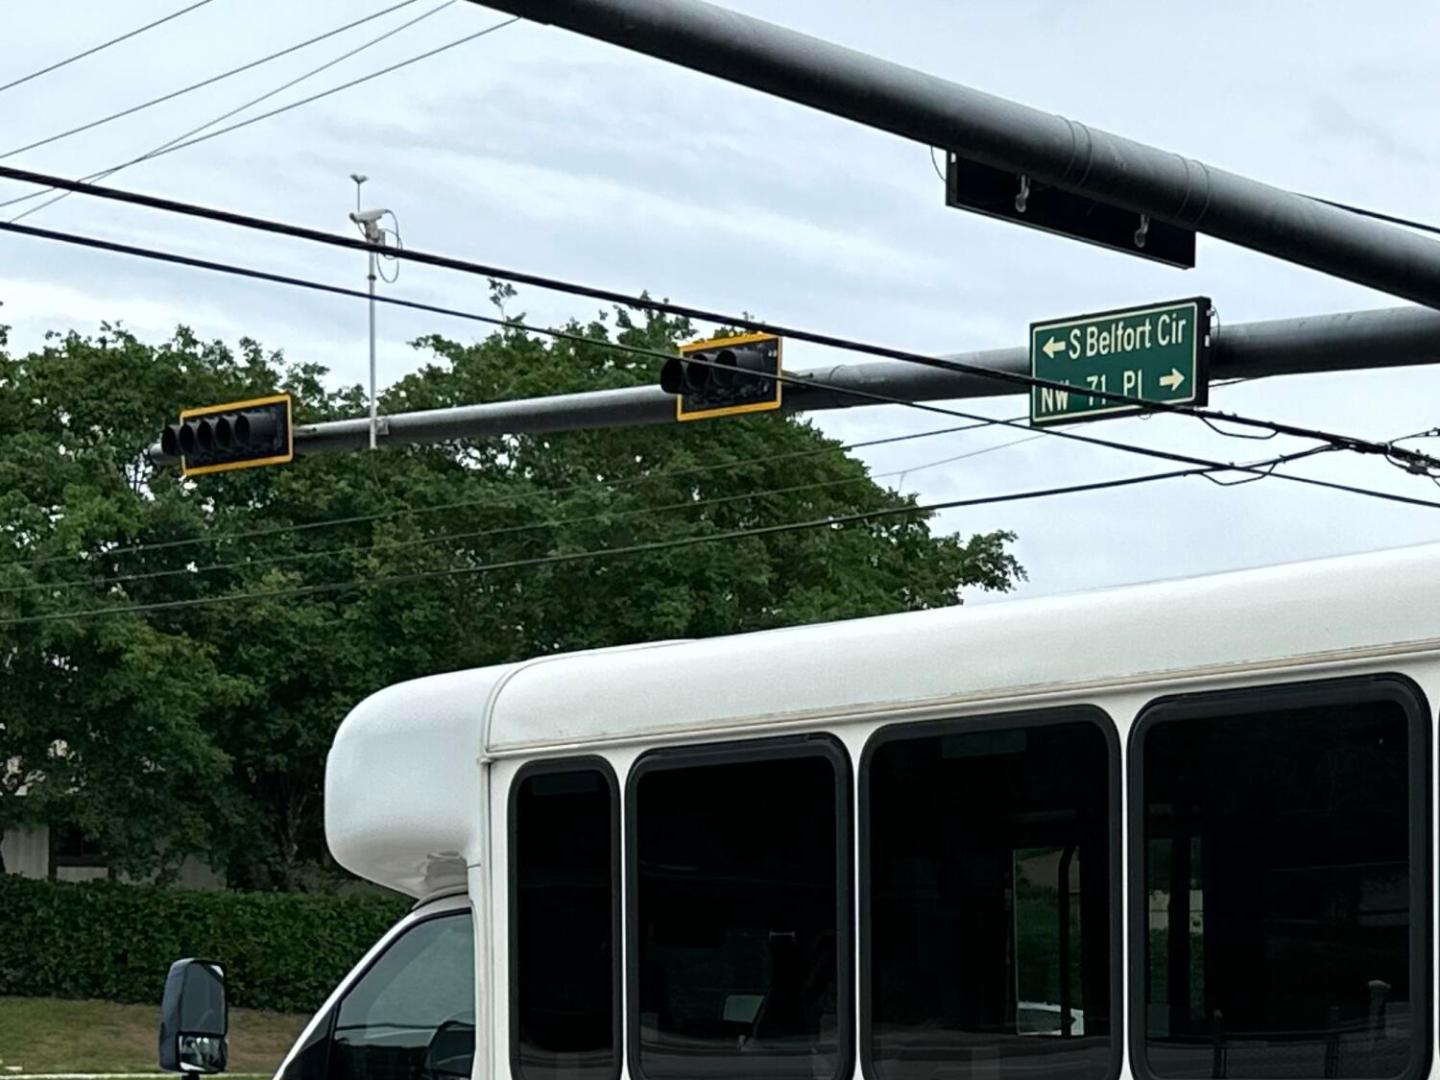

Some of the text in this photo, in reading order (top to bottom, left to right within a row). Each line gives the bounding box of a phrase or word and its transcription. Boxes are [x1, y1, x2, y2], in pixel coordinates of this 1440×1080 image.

[1068, 313, 1186, 360] S Belfort Cir
[1041, 369, 1143, 412] NW 71 Pl
